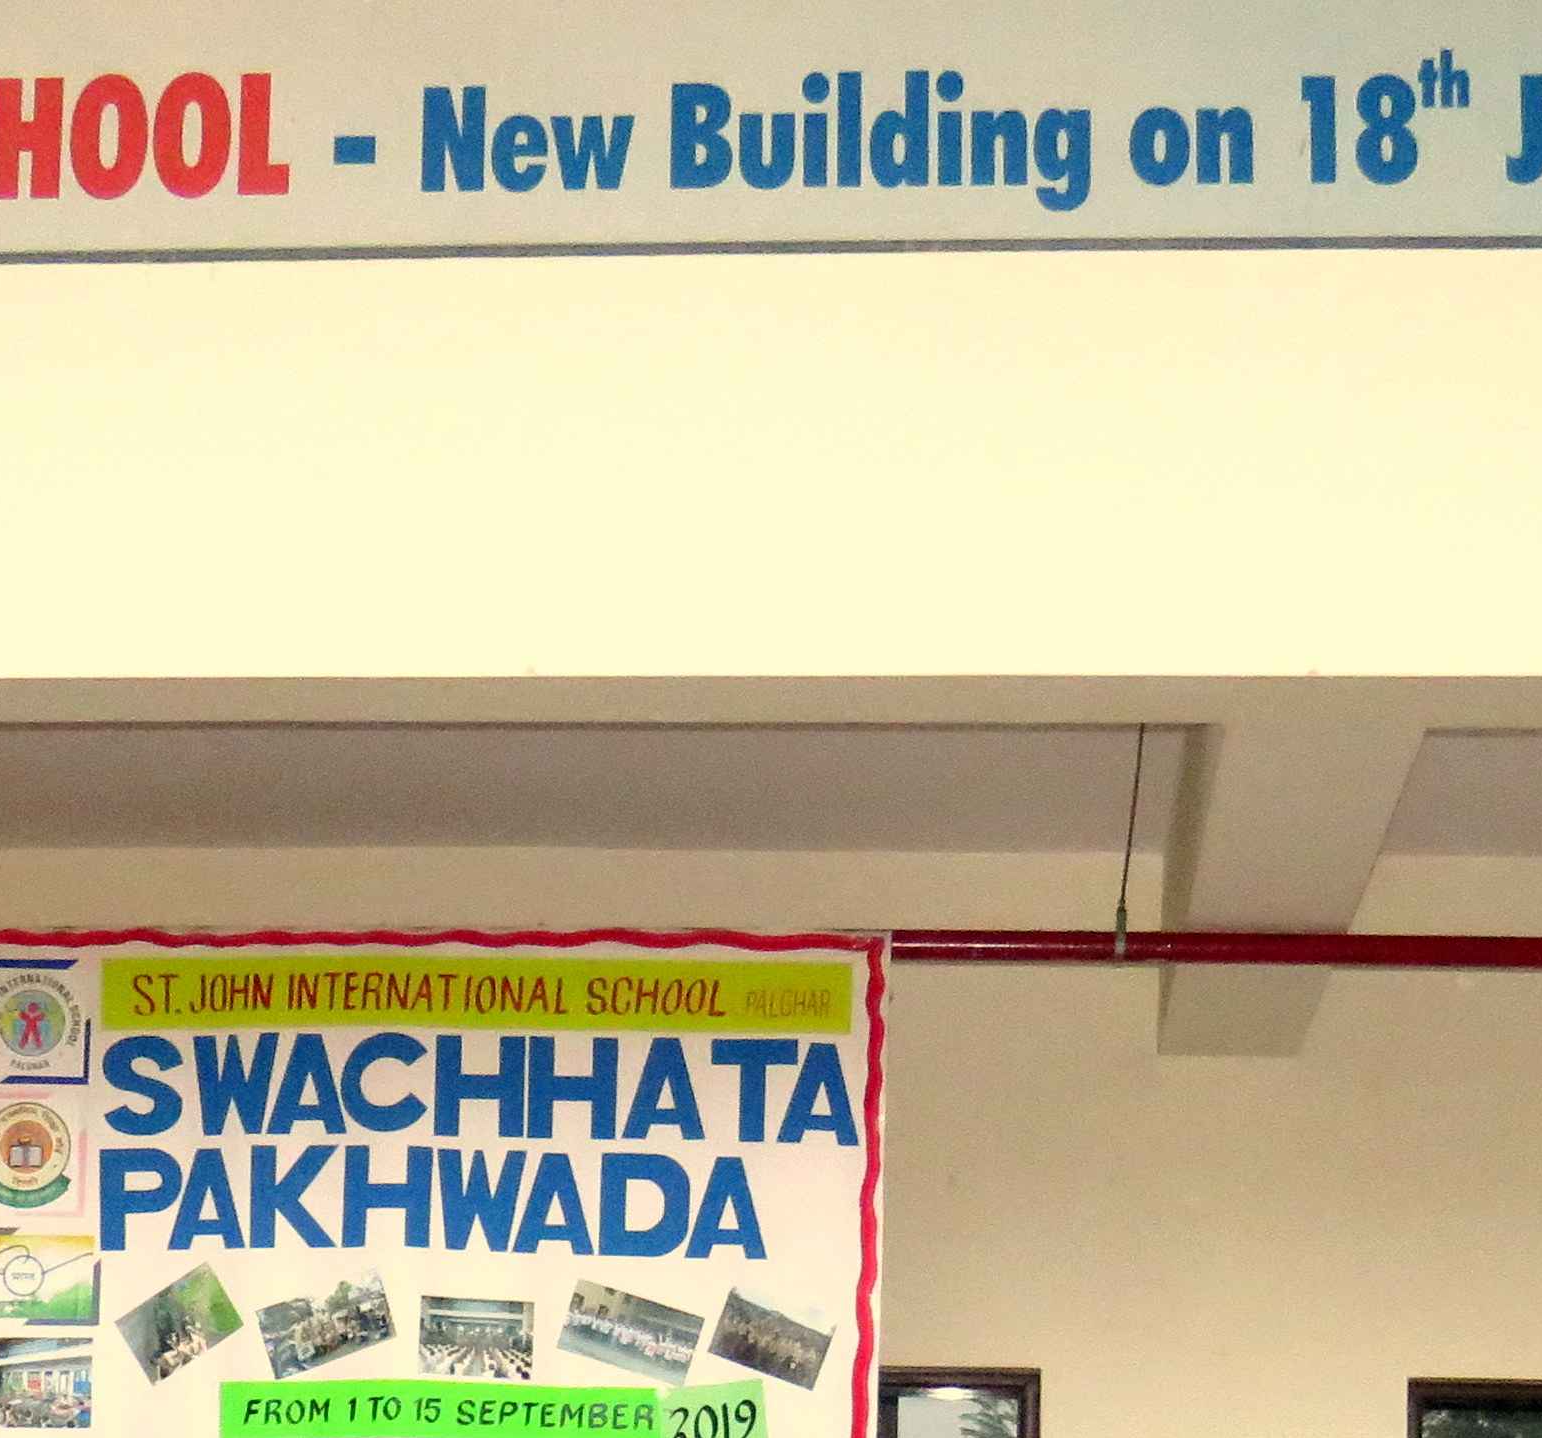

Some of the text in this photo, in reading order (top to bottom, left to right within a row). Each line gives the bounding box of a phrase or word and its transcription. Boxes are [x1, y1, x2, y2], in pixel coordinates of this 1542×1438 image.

[422, 85, 628, 193] New
[670, 71, 1090, 212] Building
[1128, 104, 1252, 189] on
[1300, 49, 1470, 186] 18th
[190, 973, 274, 1014] JOHN
[287, 971, 568, 1015] INTERNATIONAL
[585, 976, 727, 1017] SCHOOL
[743, 988, 832, 1019] PALGHAR
[102, 1031, 860, 1147] SWACHHATA
[98, 1144, 767, 1260] PAKHWADA
[243, 1398, 330, 1426] FROM
[348, 1397, 358, 1423] 1
[369, 1396, 403, 1422] TO
[416, 1397, 442, 1424] 15
[456, 1399, 655, 1432] SEPTEMBER
